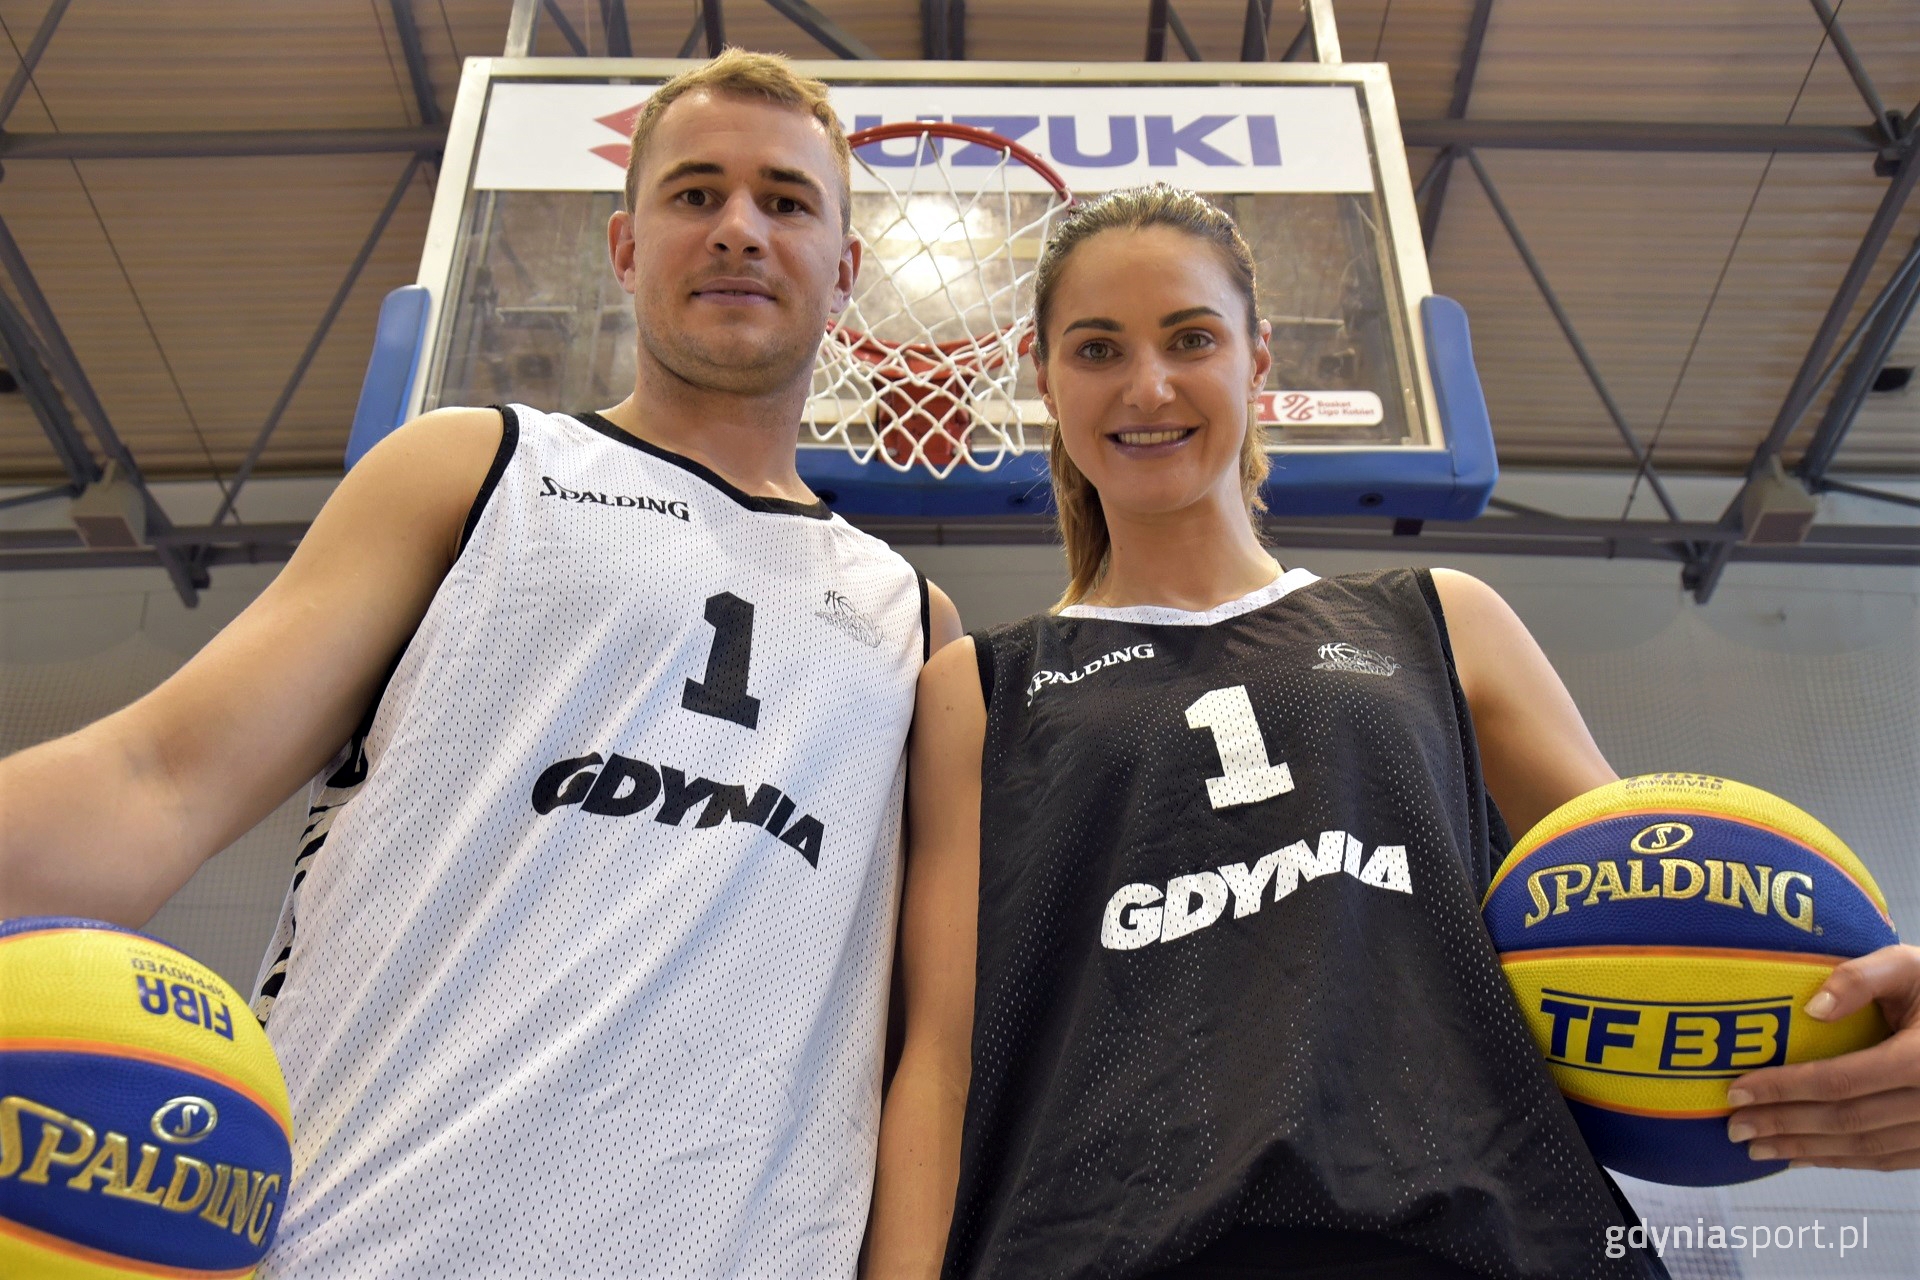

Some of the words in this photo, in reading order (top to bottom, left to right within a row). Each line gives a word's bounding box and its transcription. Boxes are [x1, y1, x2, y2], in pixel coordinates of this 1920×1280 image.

[843, 113, 1283, 168] UZUKI
[540, 476, 690, 522] SPALDING
[681, 591, 761, 731] 1
[1185, 685, 1295, 810] 1
[532, 751, 825, 870] GDYNIA
[1101, 830, 1413, 950] GDYNIA
[1525, 858, 1815, 934] SPALDING
[136, 973, 235, 1041] FIBA
[1540, 999, 1641, 1065] TF
